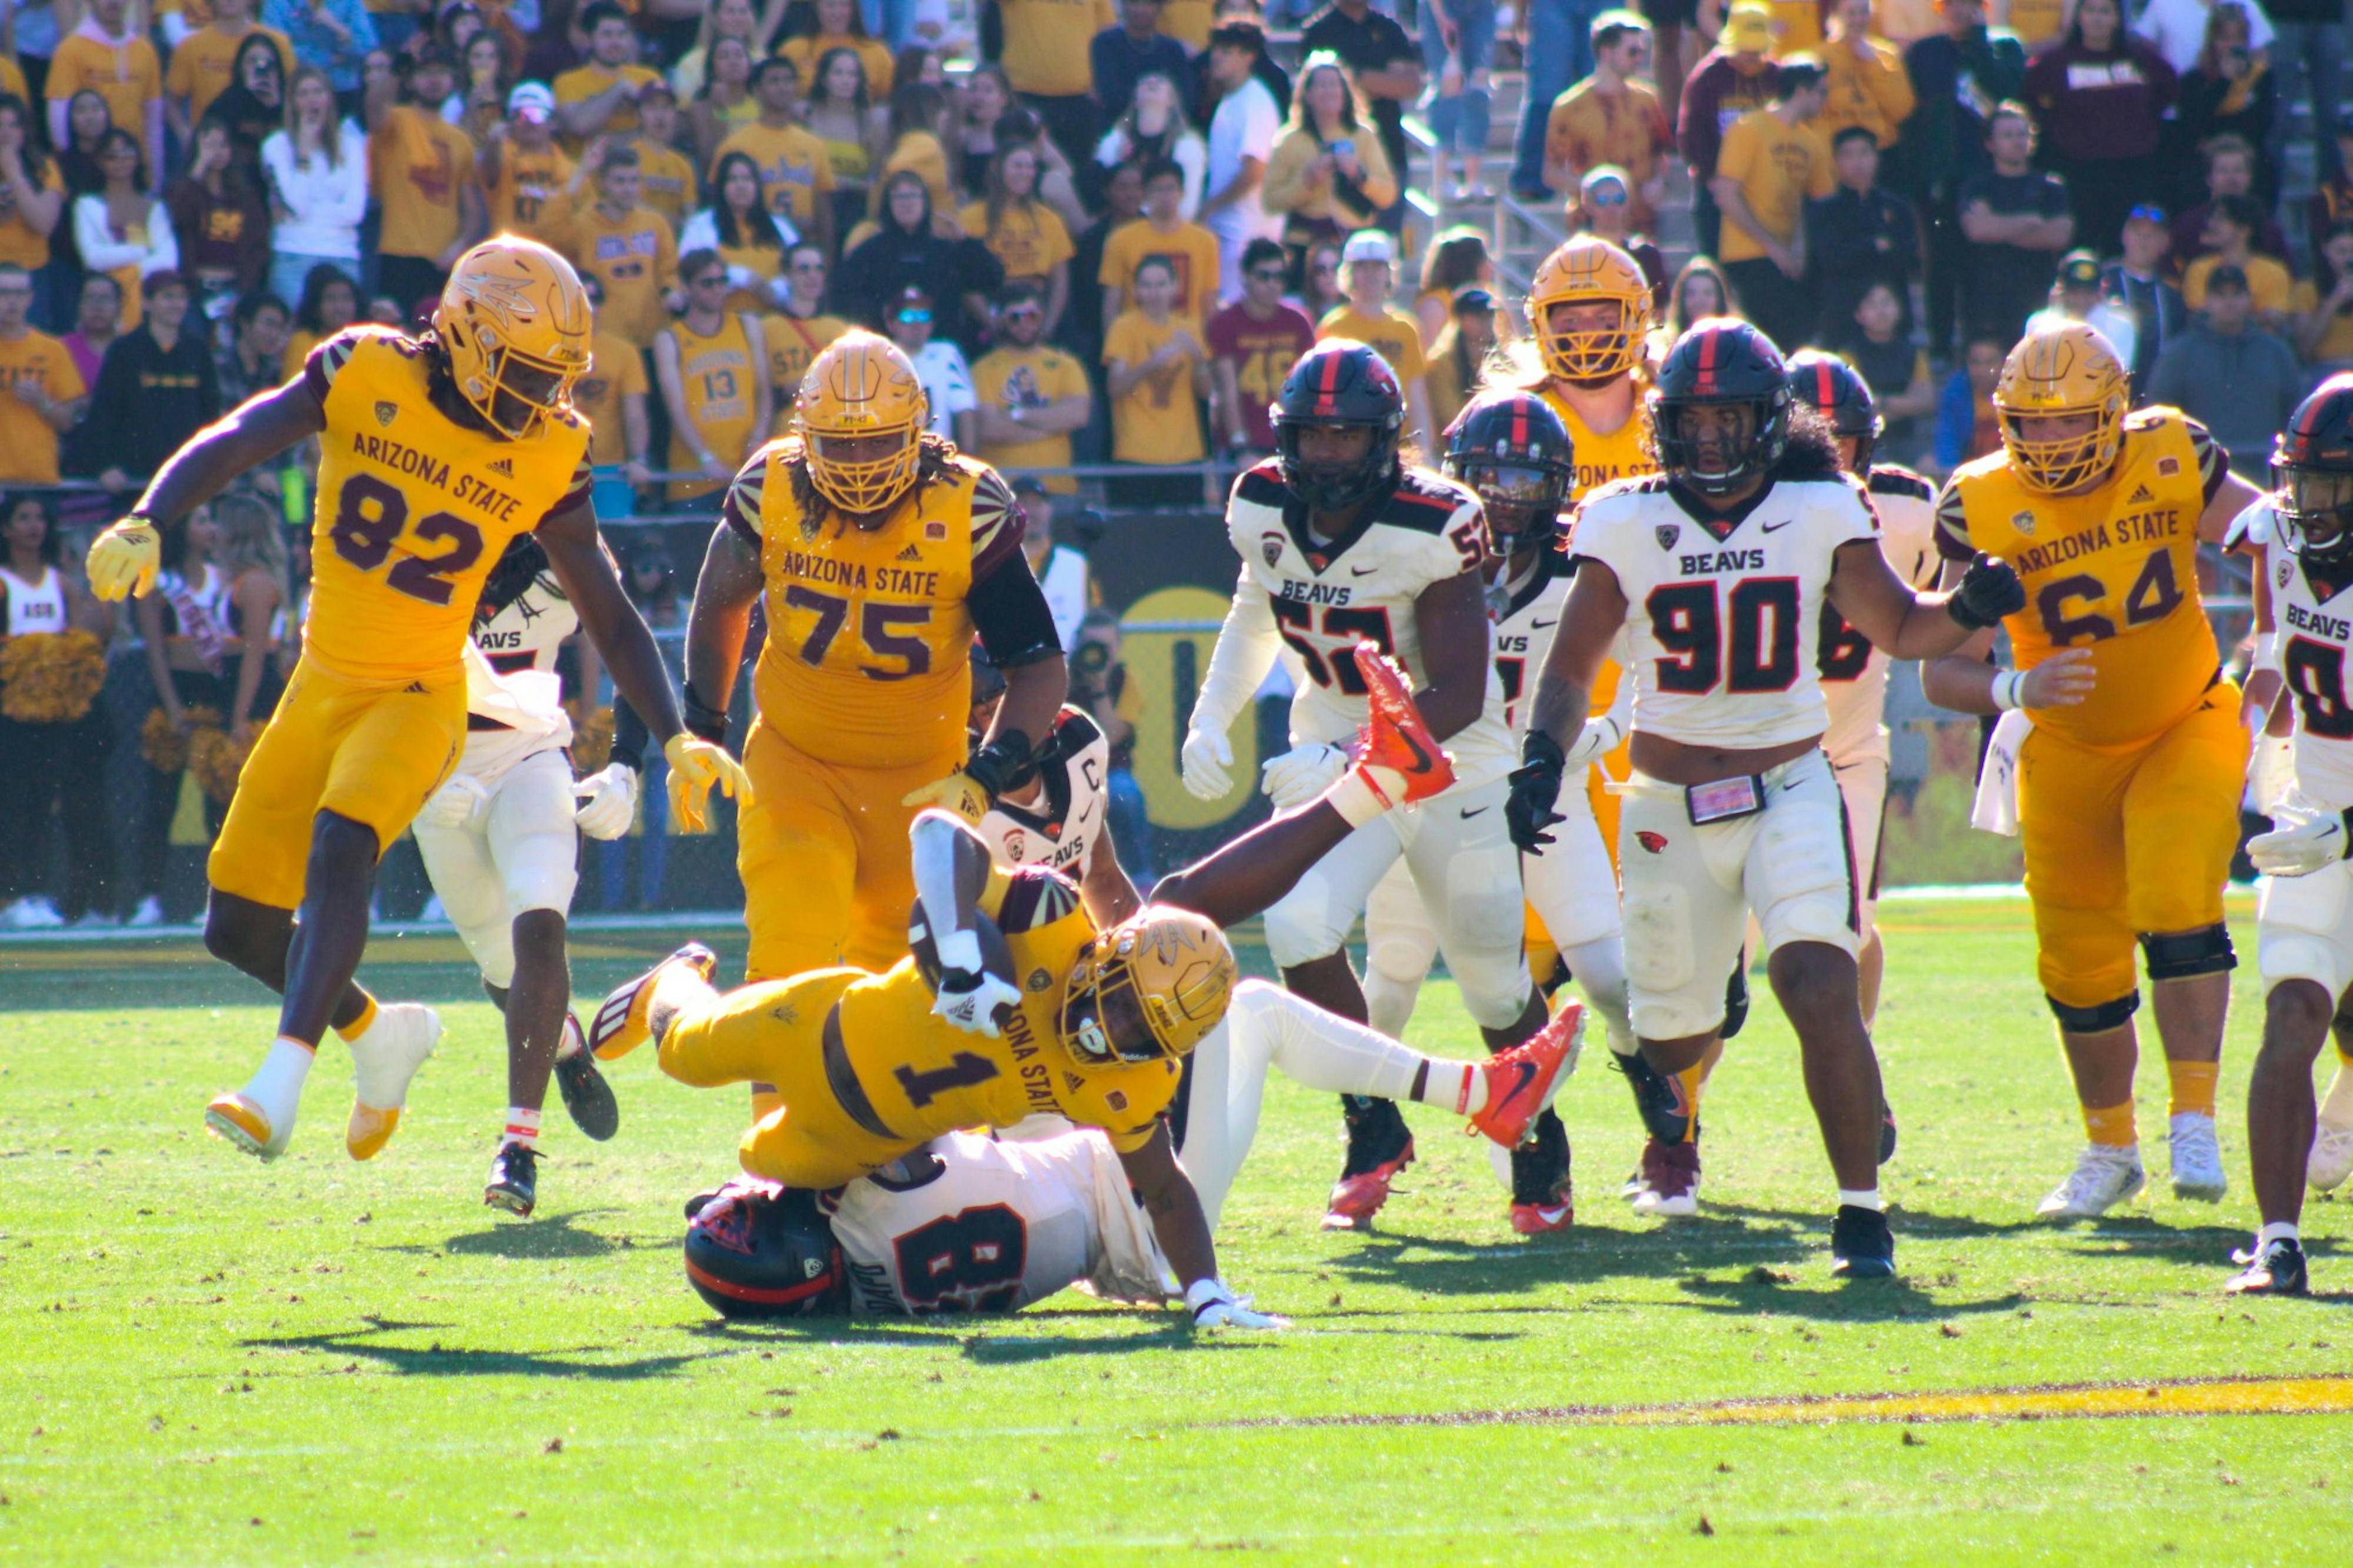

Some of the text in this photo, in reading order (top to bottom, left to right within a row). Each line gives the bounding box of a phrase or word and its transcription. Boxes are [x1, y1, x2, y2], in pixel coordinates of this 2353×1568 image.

[703, 369, 735, 401] 13
[354, 432, 522, 523] ARIZONA STATE
[331, 472, 484, 606] 82
[1681, 549, 1764, 575] BEAVS
[2017, 522, 2112, 575] ARIZONA
[2115, 510, 2179, 543] STATE
[783, 550, 939, 596] ARIZONA STATE
[1280, 579, 1351, 606] BEAVS
[2037, 549, 2184, 646] 64
[478, 631, 521, 649] AVS
[785, 583, 932, 682] 75
[1645, 576, 1801, 696] 90
[2286, 602, 2351, 641] BEAVS
[1081, 758, 1099, 791] C
[892, 1050, 1002, 1110] 1
